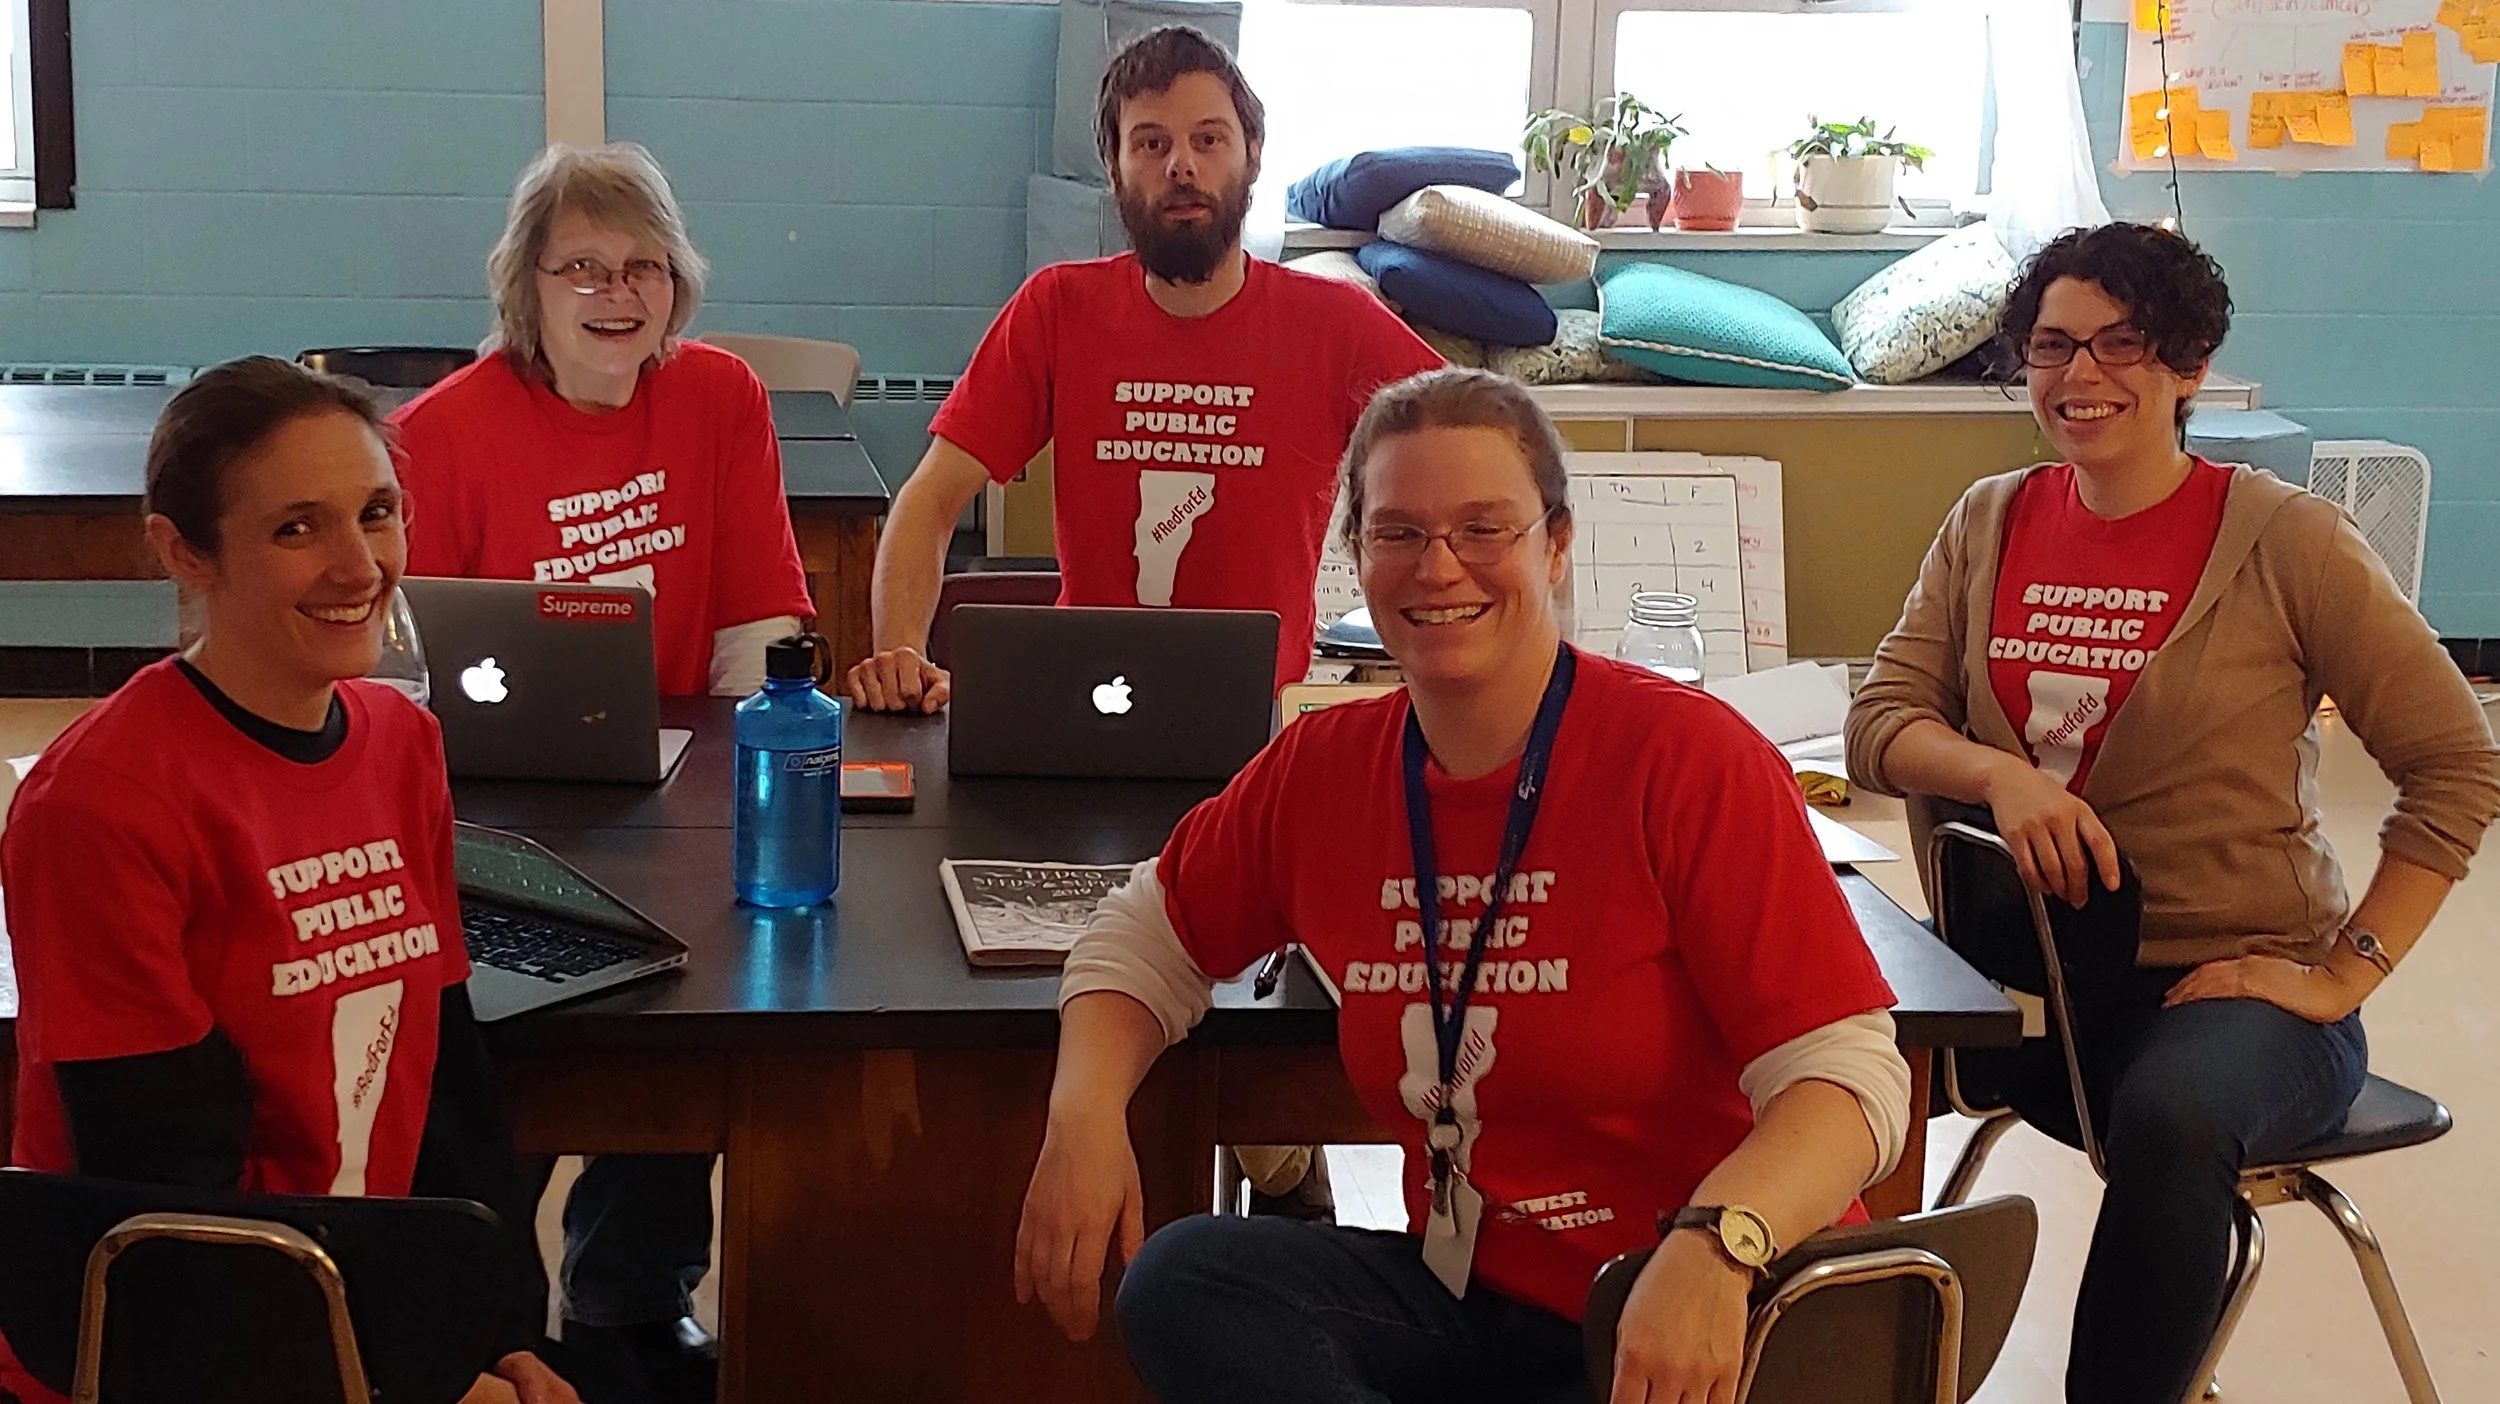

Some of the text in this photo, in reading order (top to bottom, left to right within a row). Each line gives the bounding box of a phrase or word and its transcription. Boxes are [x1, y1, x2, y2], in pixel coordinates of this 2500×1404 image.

[1115, 382, 1254, 407] SUPPORT
[1126, 411, 1236, 435] PUBLIC
[1096, 440, 1264, 466] EDUCATION
[1609, 482, 1700, 499] Th F
[561, 503, 658, 549] PUBLIC
[1151, 485, 1207, 544] #RedForEd
[1693, 540, 1706, 553] 2
[1701, 578, 1714, 592] 4
[2022, 583, 2170, 613] SUPPORT
[543, 596, 632, 617] Supreme
[2026, 612, 2145, 641] PUBLIC
[2042, 692, 2099, 747] #RedForEd
[267, 838, 405, 900] SUPPORT
[291, 884, 405, 942] PUBLIC
[272, 923, 440, 997] EDUCATION
